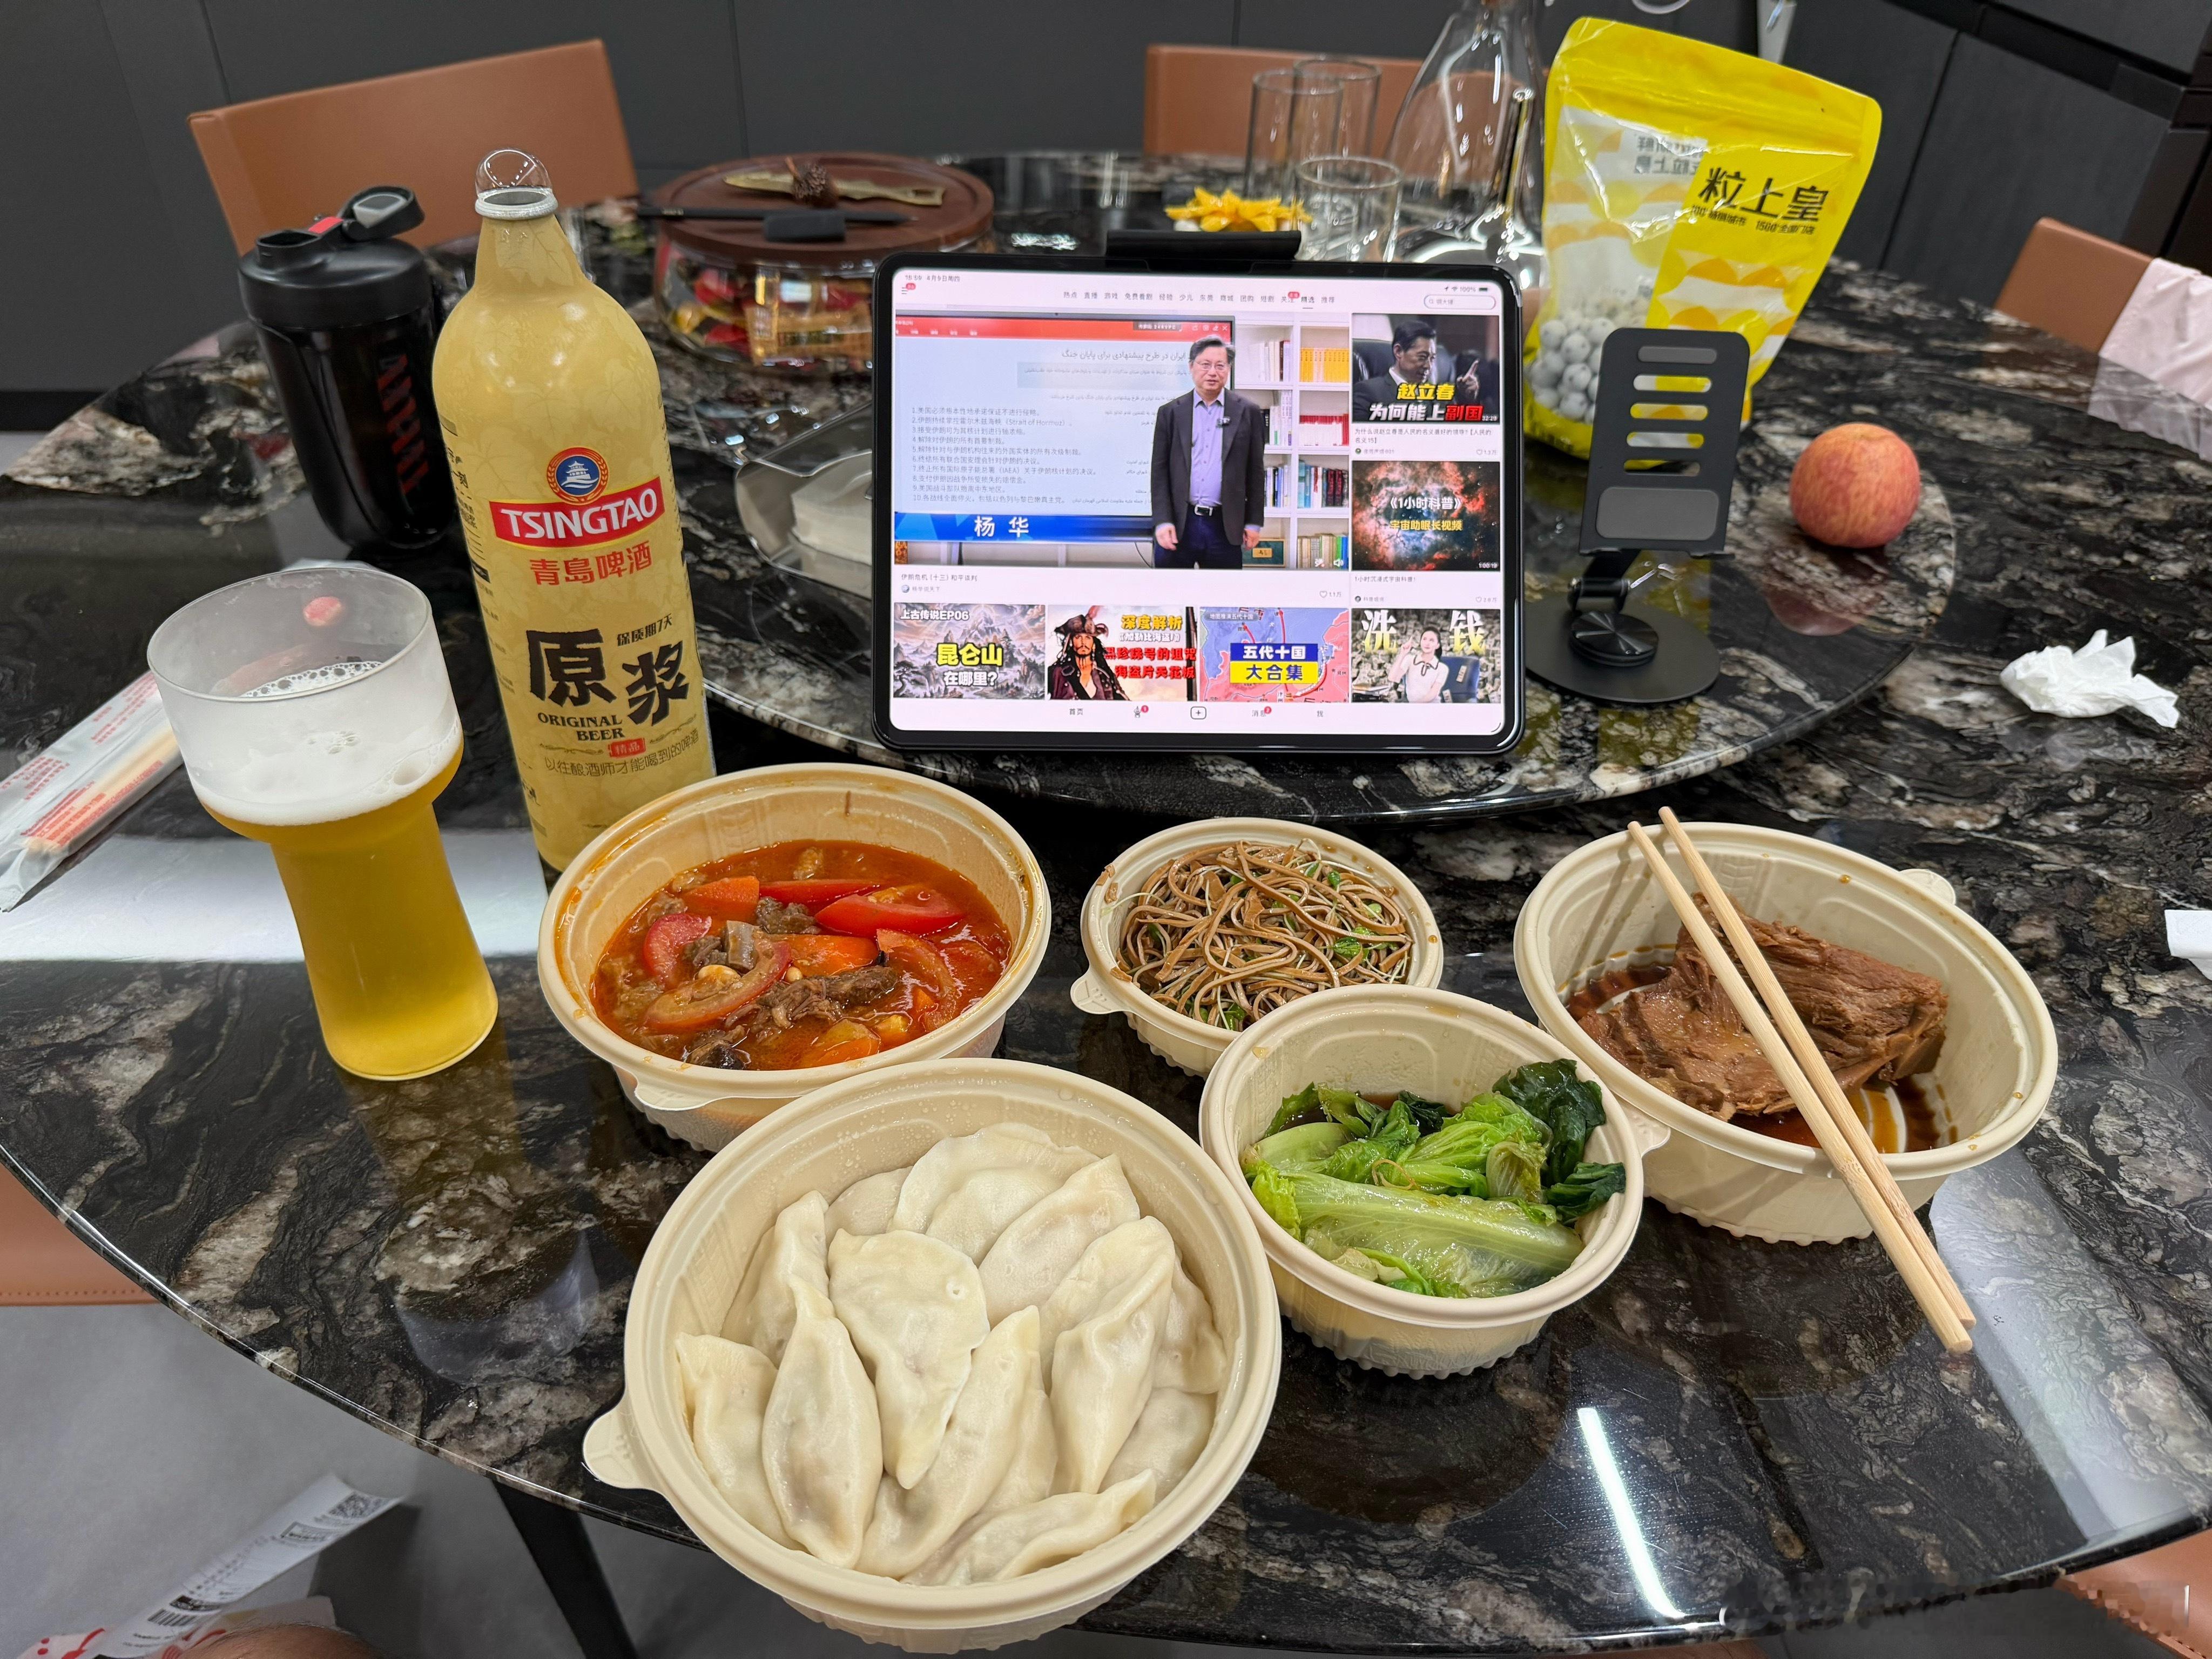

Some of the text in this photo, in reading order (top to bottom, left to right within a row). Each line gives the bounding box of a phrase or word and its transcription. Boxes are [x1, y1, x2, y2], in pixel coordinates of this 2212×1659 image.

[1698, 167, 1829, 221] 粒上皇
[1397, 383, 1456, 400] 赵立春
[1368, 403, 1483, 421] 为何能上副国
[1390, 496, 1462, 510] 《1小时科普》
[501, 488, 657, 539] TSINGTAO
[974, 516, 1029, 538] 杨 华
[1389, 520, 1463, 531] 宇宙助眠长视频
[529, 541, 652, 585] 青岛啤酒
[900, 610, 969, 621] 上古传说EP06
[1121, 615, 1182, 630] 深度解析
[617, 613, 672, 646] 保质期7天
[1363, 610, 1485, 654] 洗 钱
[936, 644, 1003, 666] 昆仑山
[1243, 646, 1306, 659] 五代十国
[527, 629, 617, 707] 原
[622, 641, 689, 726] 浆
[1246, 664, 1303, 680] 大合集
[538, 713, 622, 728] ORIGINAL
[576, 728, 625, 741] BEER
[544, 729, 699, 777] 以往酿酒师才能喝到的啤酒
[615, 741, 640, 755] 精品
